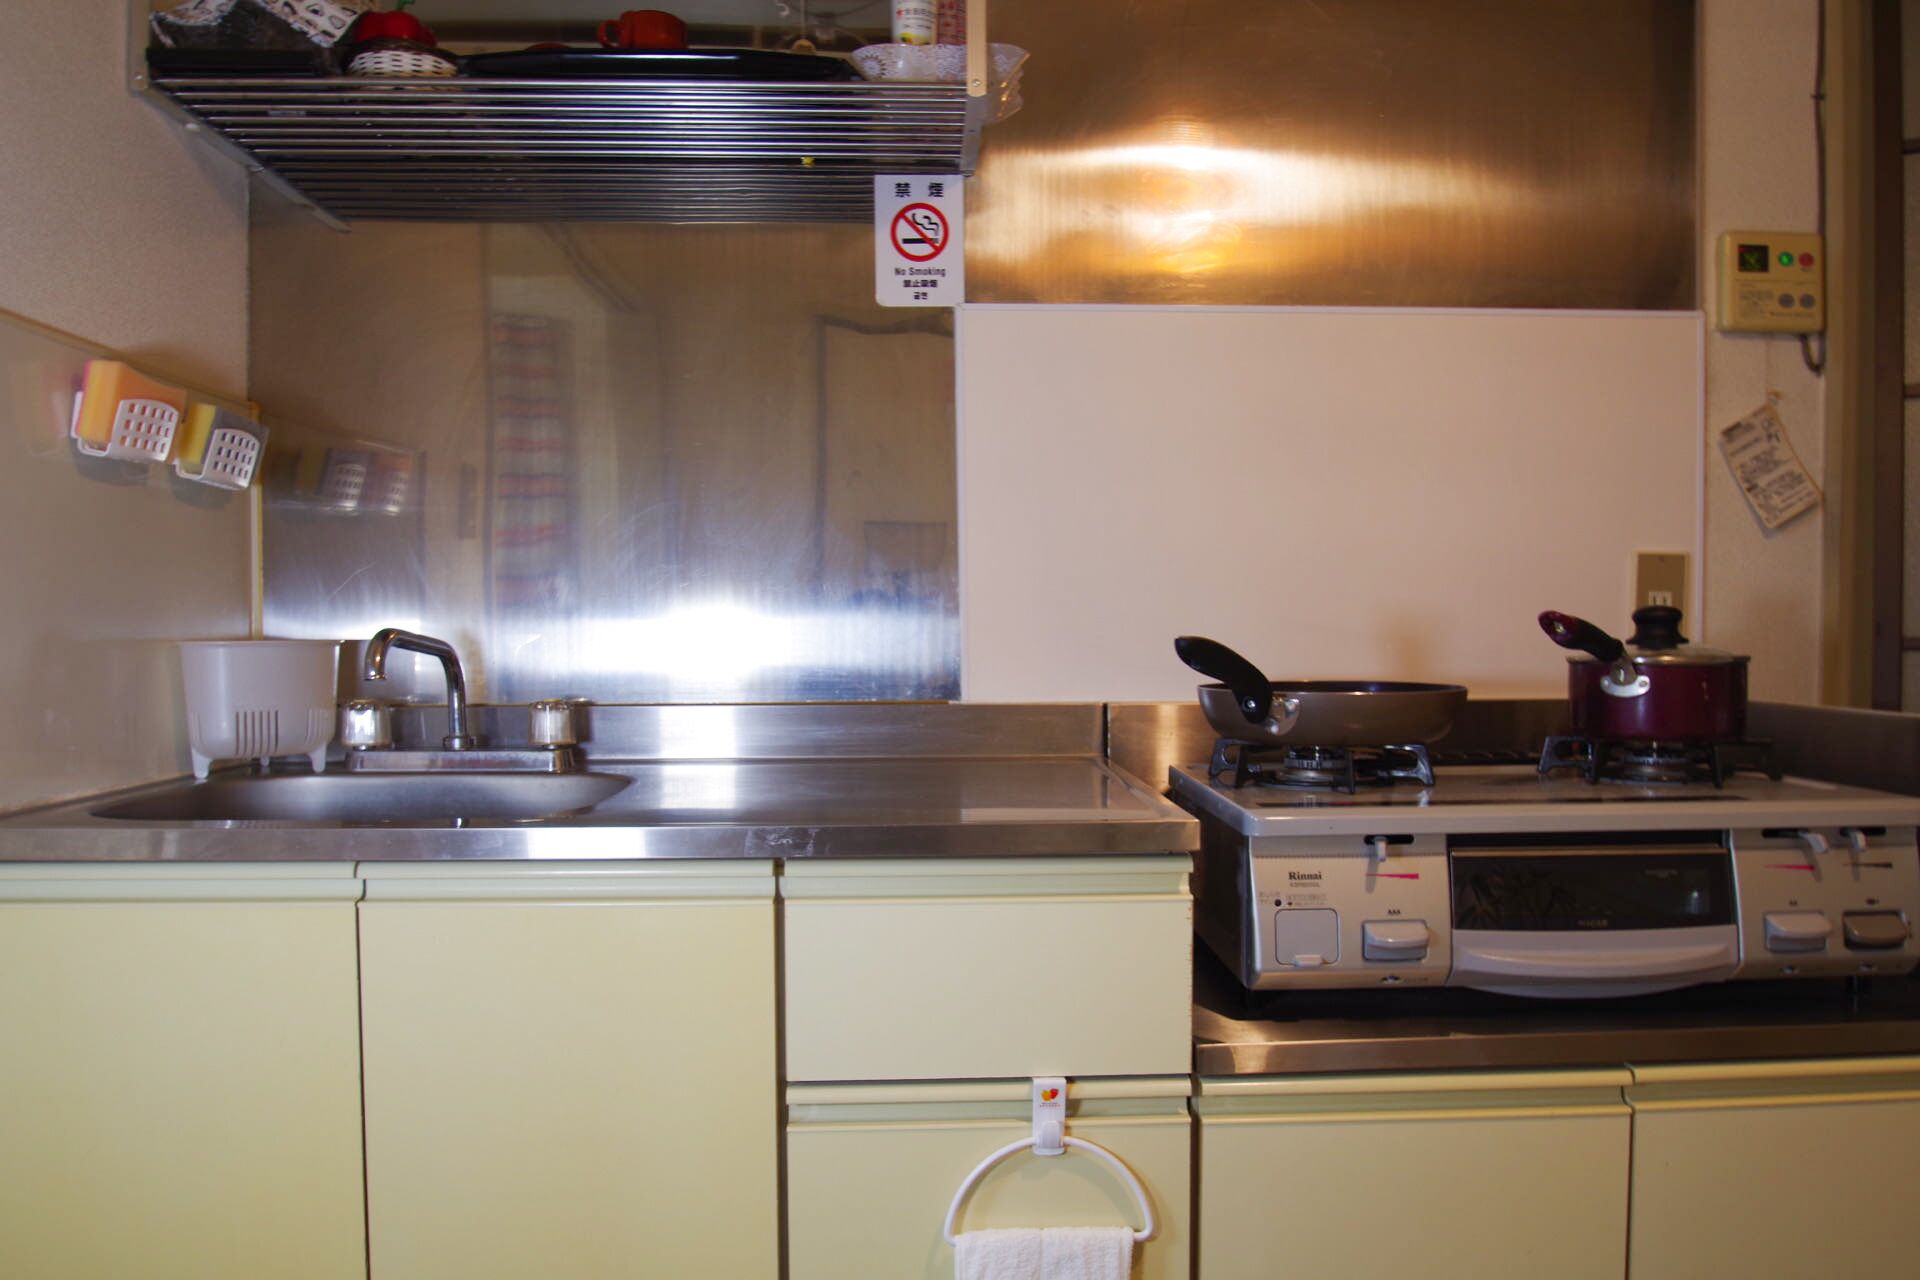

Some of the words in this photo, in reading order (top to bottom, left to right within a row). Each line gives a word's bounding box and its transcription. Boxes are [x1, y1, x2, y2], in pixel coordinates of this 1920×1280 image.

[894, 267, 906, 275] No
[909, 267, 946, 277] Smoking
[1288, 871, 1322, 880] Rinnai
